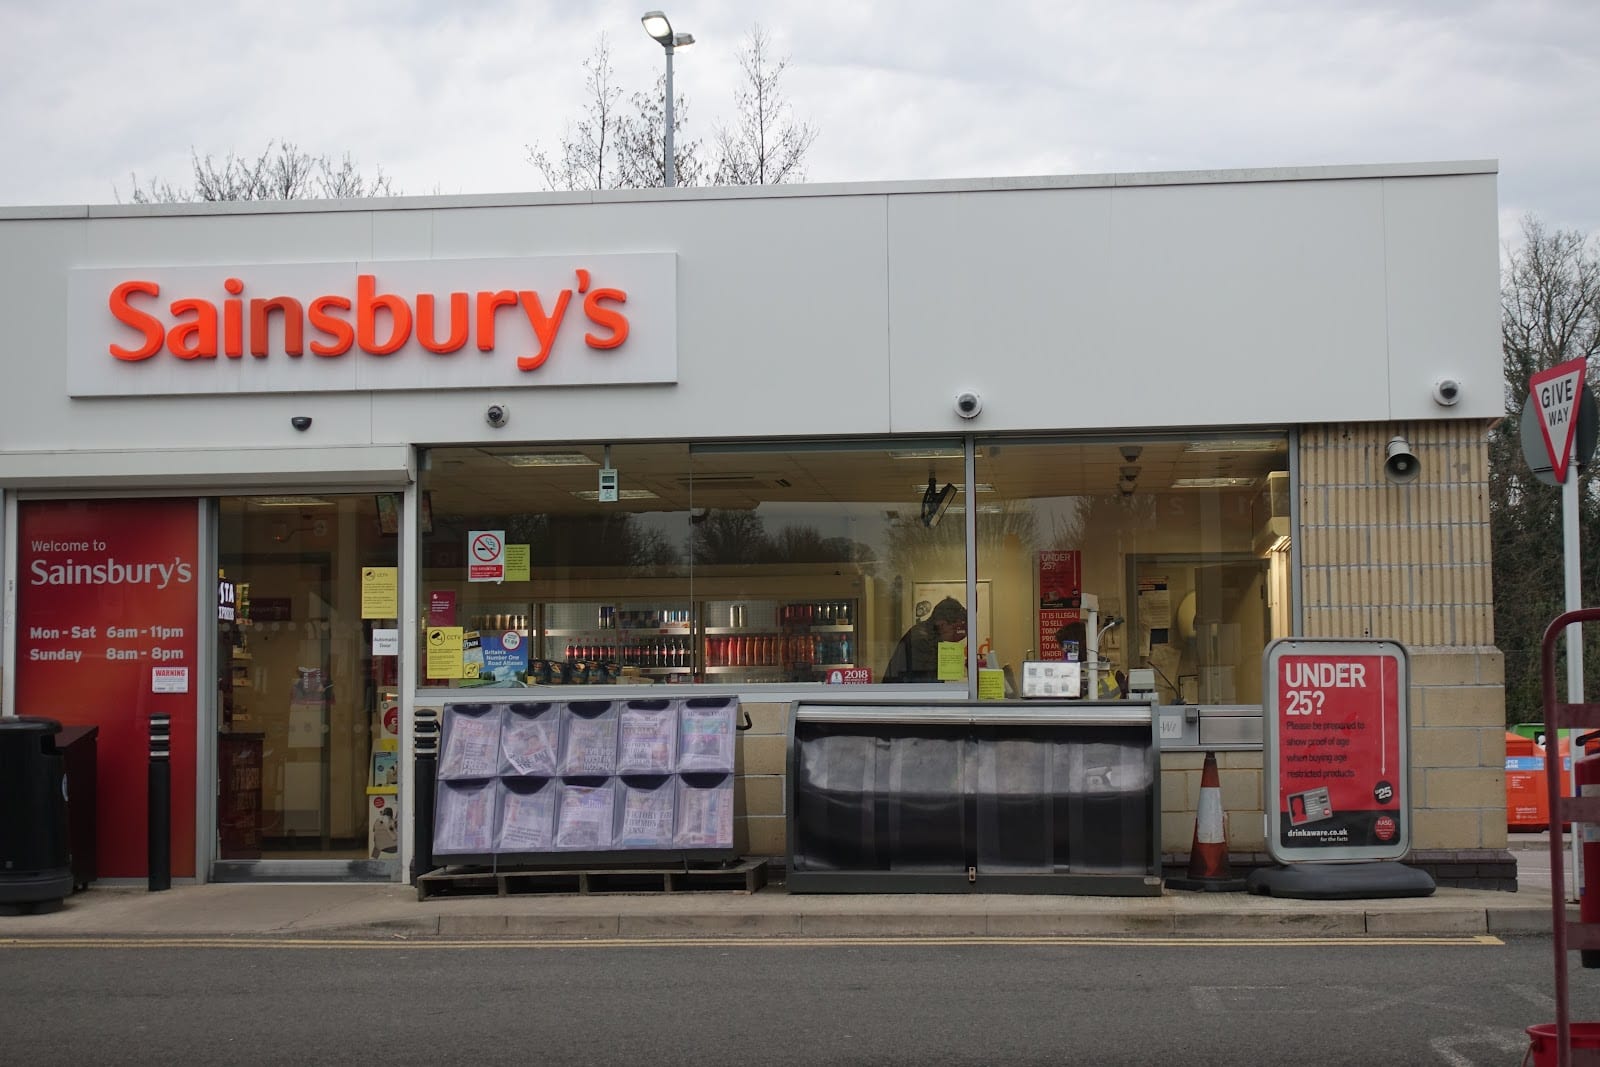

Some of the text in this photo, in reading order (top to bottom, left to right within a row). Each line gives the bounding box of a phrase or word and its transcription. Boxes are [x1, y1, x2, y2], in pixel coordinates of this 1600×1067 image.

[108, 269, 630, 372] Sainsbury's
[1541, 378, 1573, 409] GIVE
[1548, 406, 1569, 427] WAY
[31, 539, 106, 552] Welcome to
[1041, 553, 1071, 562] UNDER
[31, 557, 192, 589] Sainsbury's
[219, 582, 234, 604] STA
[30, 627, 59, 639] Mon
[71, 626, 97, 639] Sat
[106, 626, 138, 639] 6am
[151, 625, 184, 640] 11pm
[30, 648, 82, 663] Sunday
[106, 648, 138, 660] 8am
[151, 647, 184, 661] 8pm
[155, 669, 185, 677] WARNING
[844, 670, 869, 679] 2018
[1285, 663, 1367, 688] UNDER
[1285, 690, 1326, 716] 25?
[1286, 721, 1365, 732] Please be prepared to
[1286, 737, 1350, 748] show proof of age
[1286, 753, 1347, 764] when buying age
[1286, 769, 1355, 779] restricted products
[1287, 828, 1348, 837] drinkaware.co.uk
